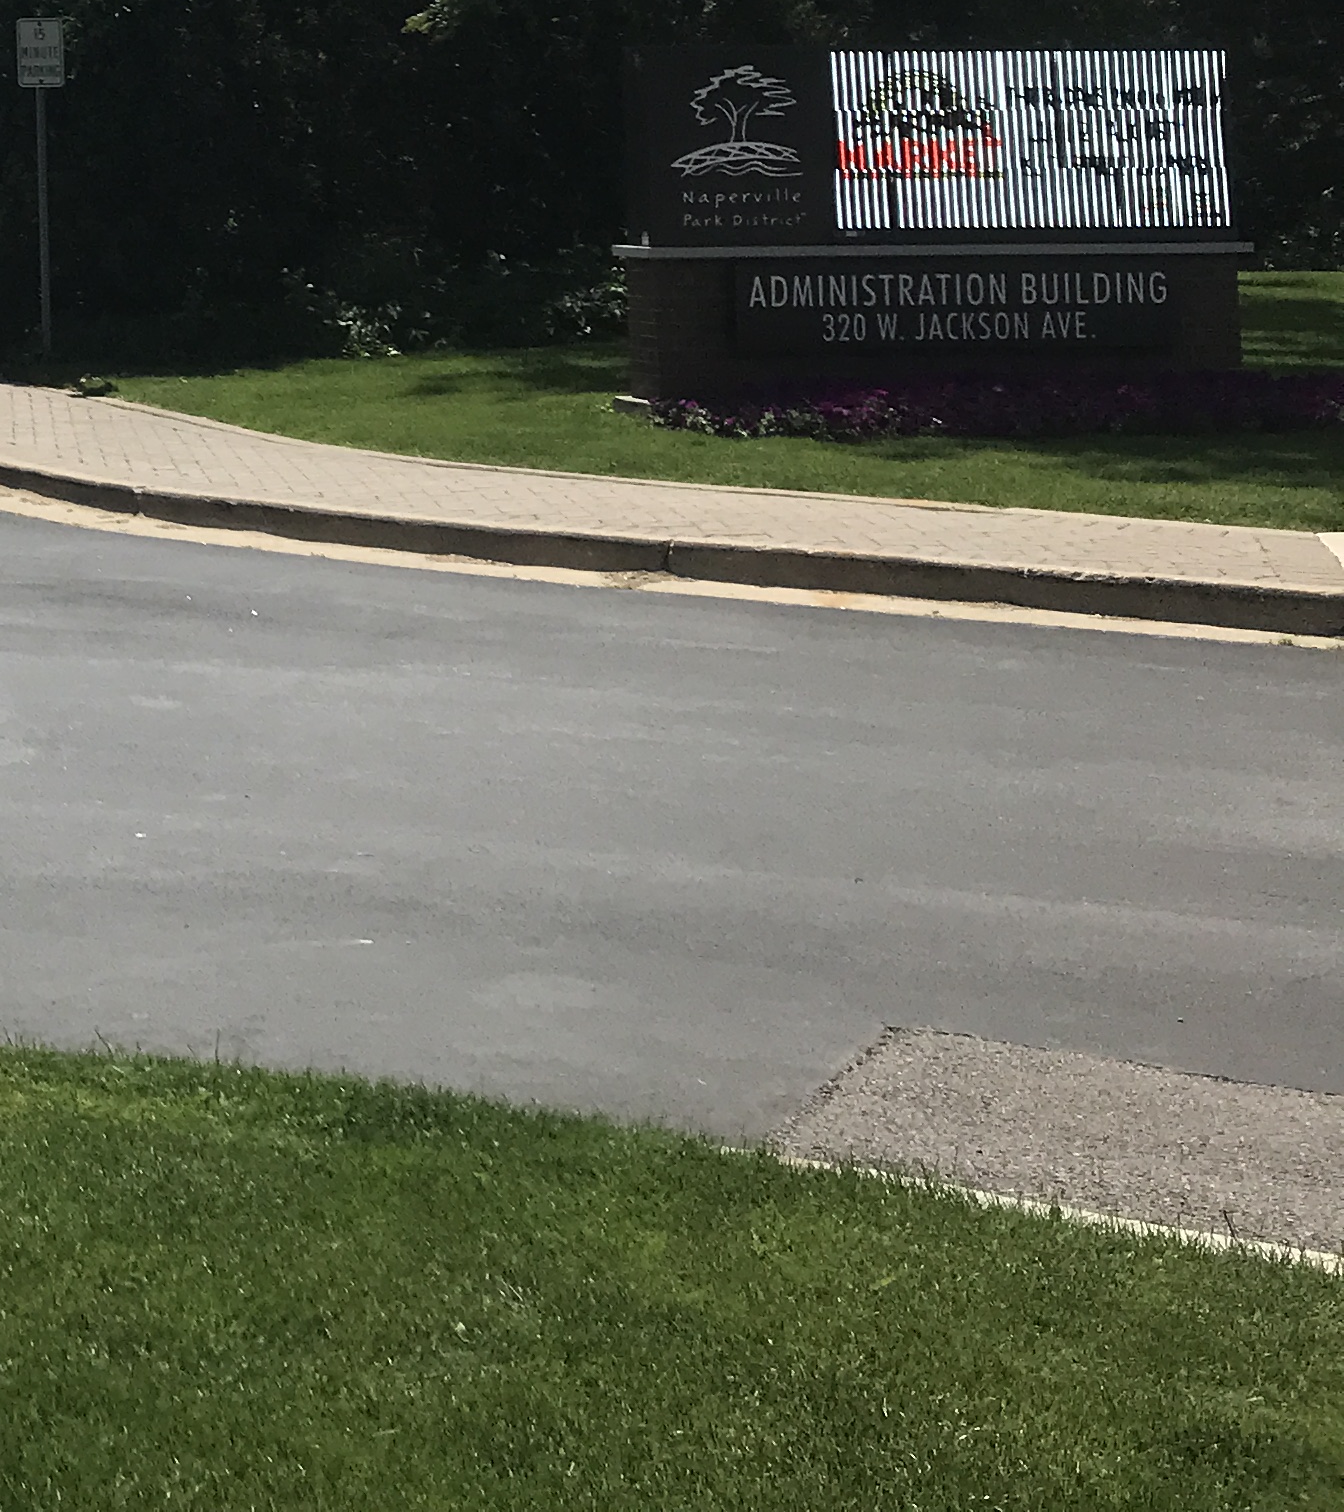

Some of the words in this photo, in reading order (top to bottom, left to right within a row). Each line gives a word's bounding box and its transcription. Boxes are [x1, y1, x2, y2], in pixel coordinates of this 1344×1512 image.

[682, 188, 802, 209] Naperville
[683, 213, 723, 227] Park
[733, 213, 801, 227] District
[749, 272, 1007, 308] ADMINISTRATION
[1022, 271, 1168, 305] BUILDING
[822, 313, 867, 342] 320
[876, 313, 906, 340] W.
[915, 312, 1029, 340] JACKSON
[1042, 311, 1097, 339] AVE.
